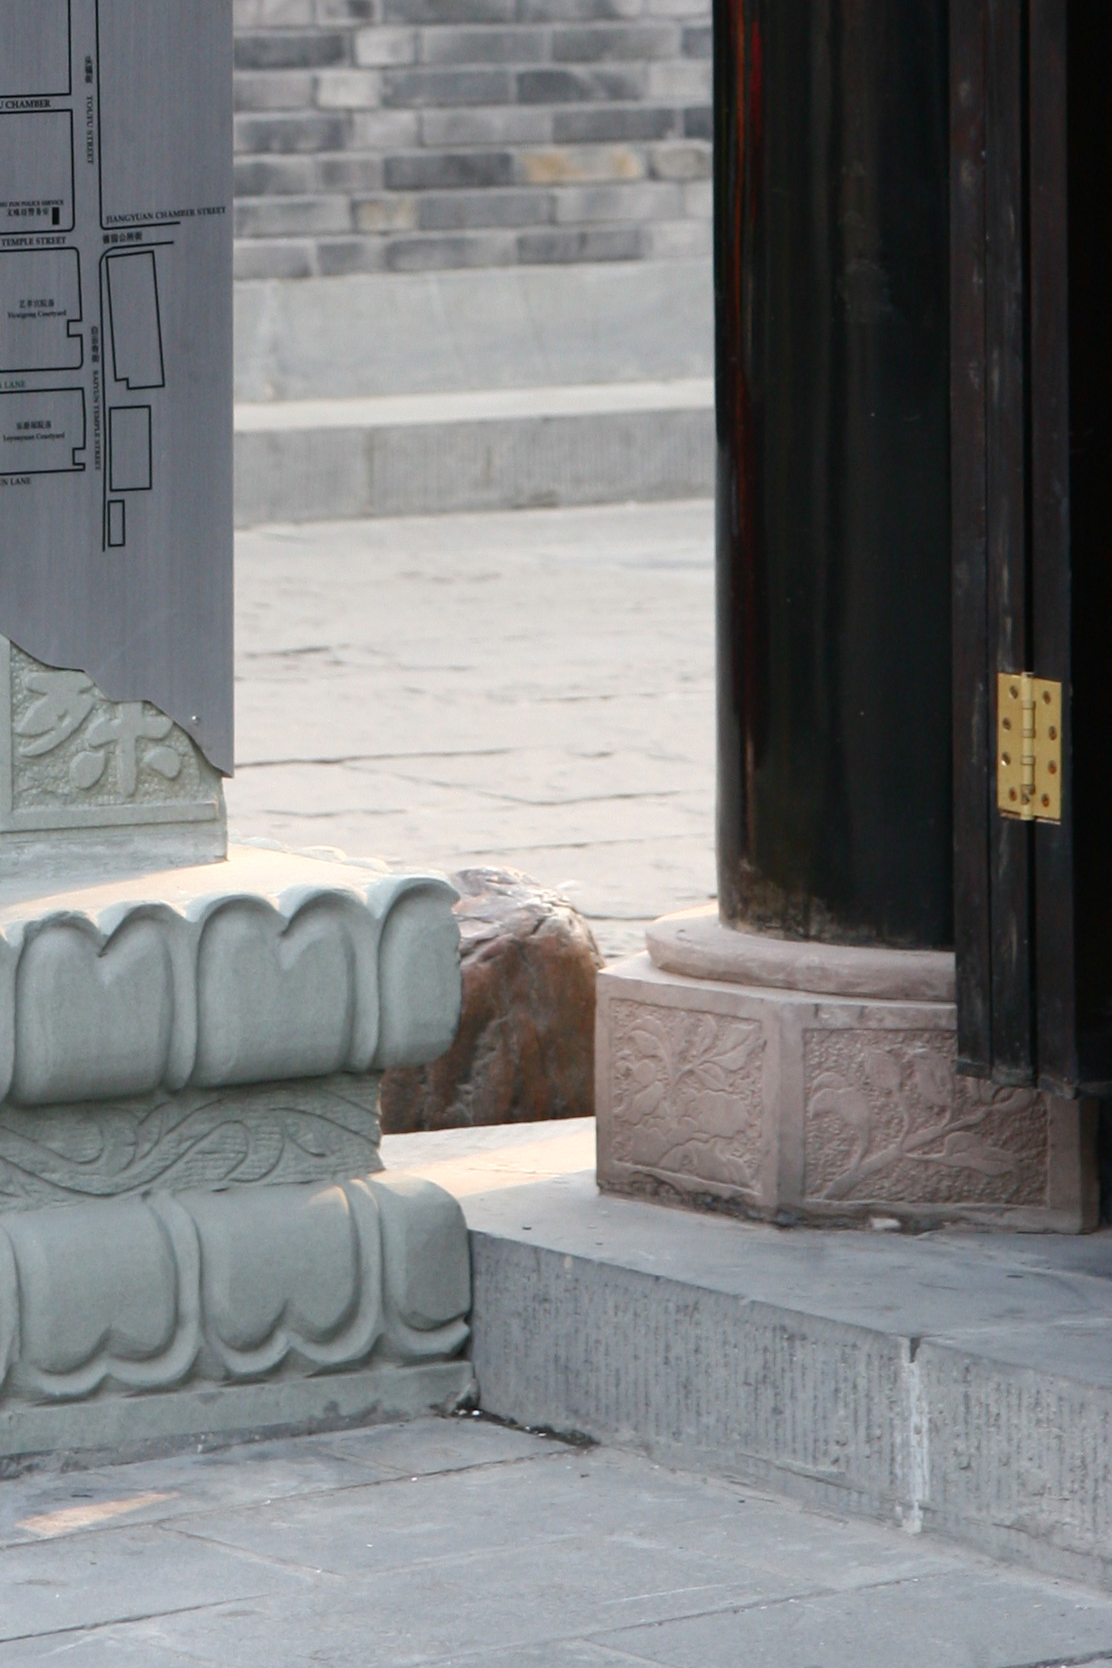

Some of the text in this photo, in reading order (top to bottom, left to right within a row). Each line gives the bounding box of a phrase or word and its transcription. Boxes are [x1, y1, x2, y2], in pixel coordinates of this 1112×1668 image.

[5, 100, 51, 109] CHAMBER
[106, 206, 226, 224] JIANGYUAN CHAMBER STREET
[2, 237, 34, 246] TEMPLE
[36, 236, 66, 245] STREET
[4, 381, 26, 389] LANE
[11, 478, 31, 486] LANE
